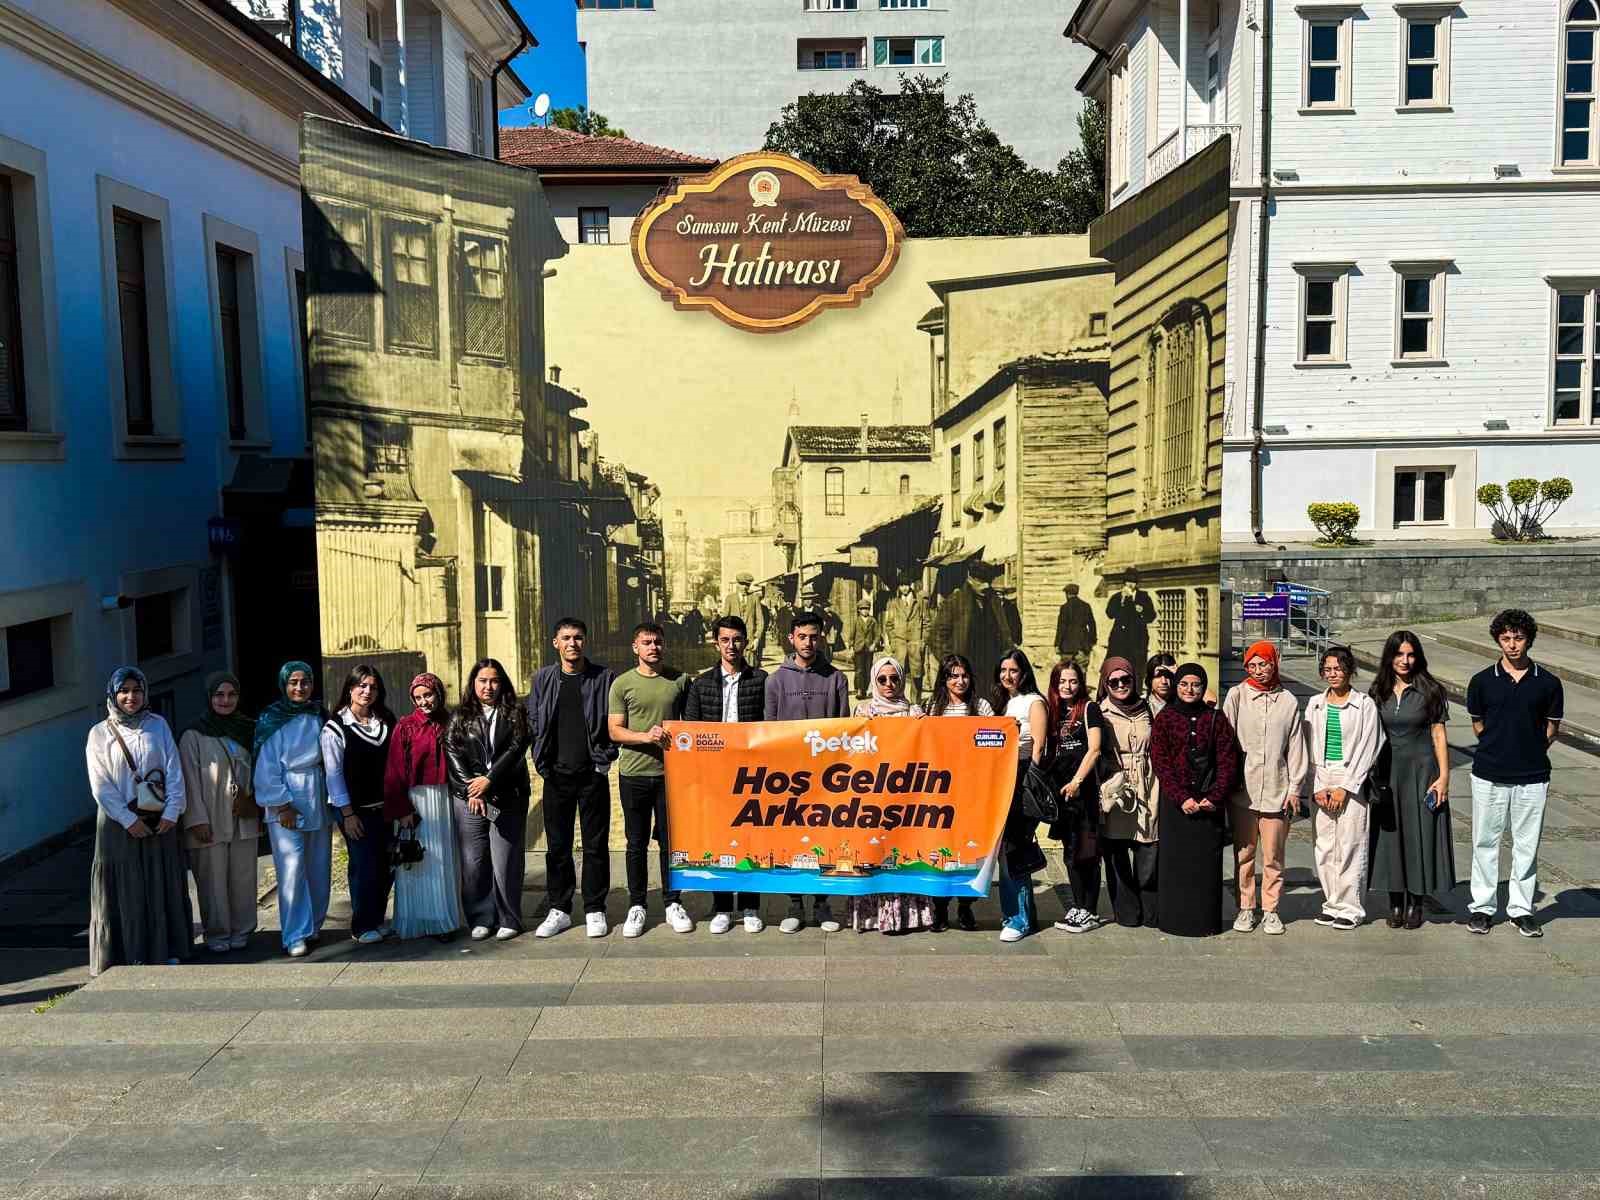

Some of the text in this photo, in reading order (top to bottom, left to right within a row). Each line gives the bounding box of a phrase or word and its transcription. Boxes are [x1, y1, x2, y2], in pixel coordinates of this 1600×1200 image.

[676, 211, 853, 235] Samsun Kent Müzesi
[689, 241, 841, 287] Hatırası
[803, 730, 879, 757] petek
[732, 762, 952, 796] Hoş Geldin
[730, 797, 955, 831] Arkadaşım
